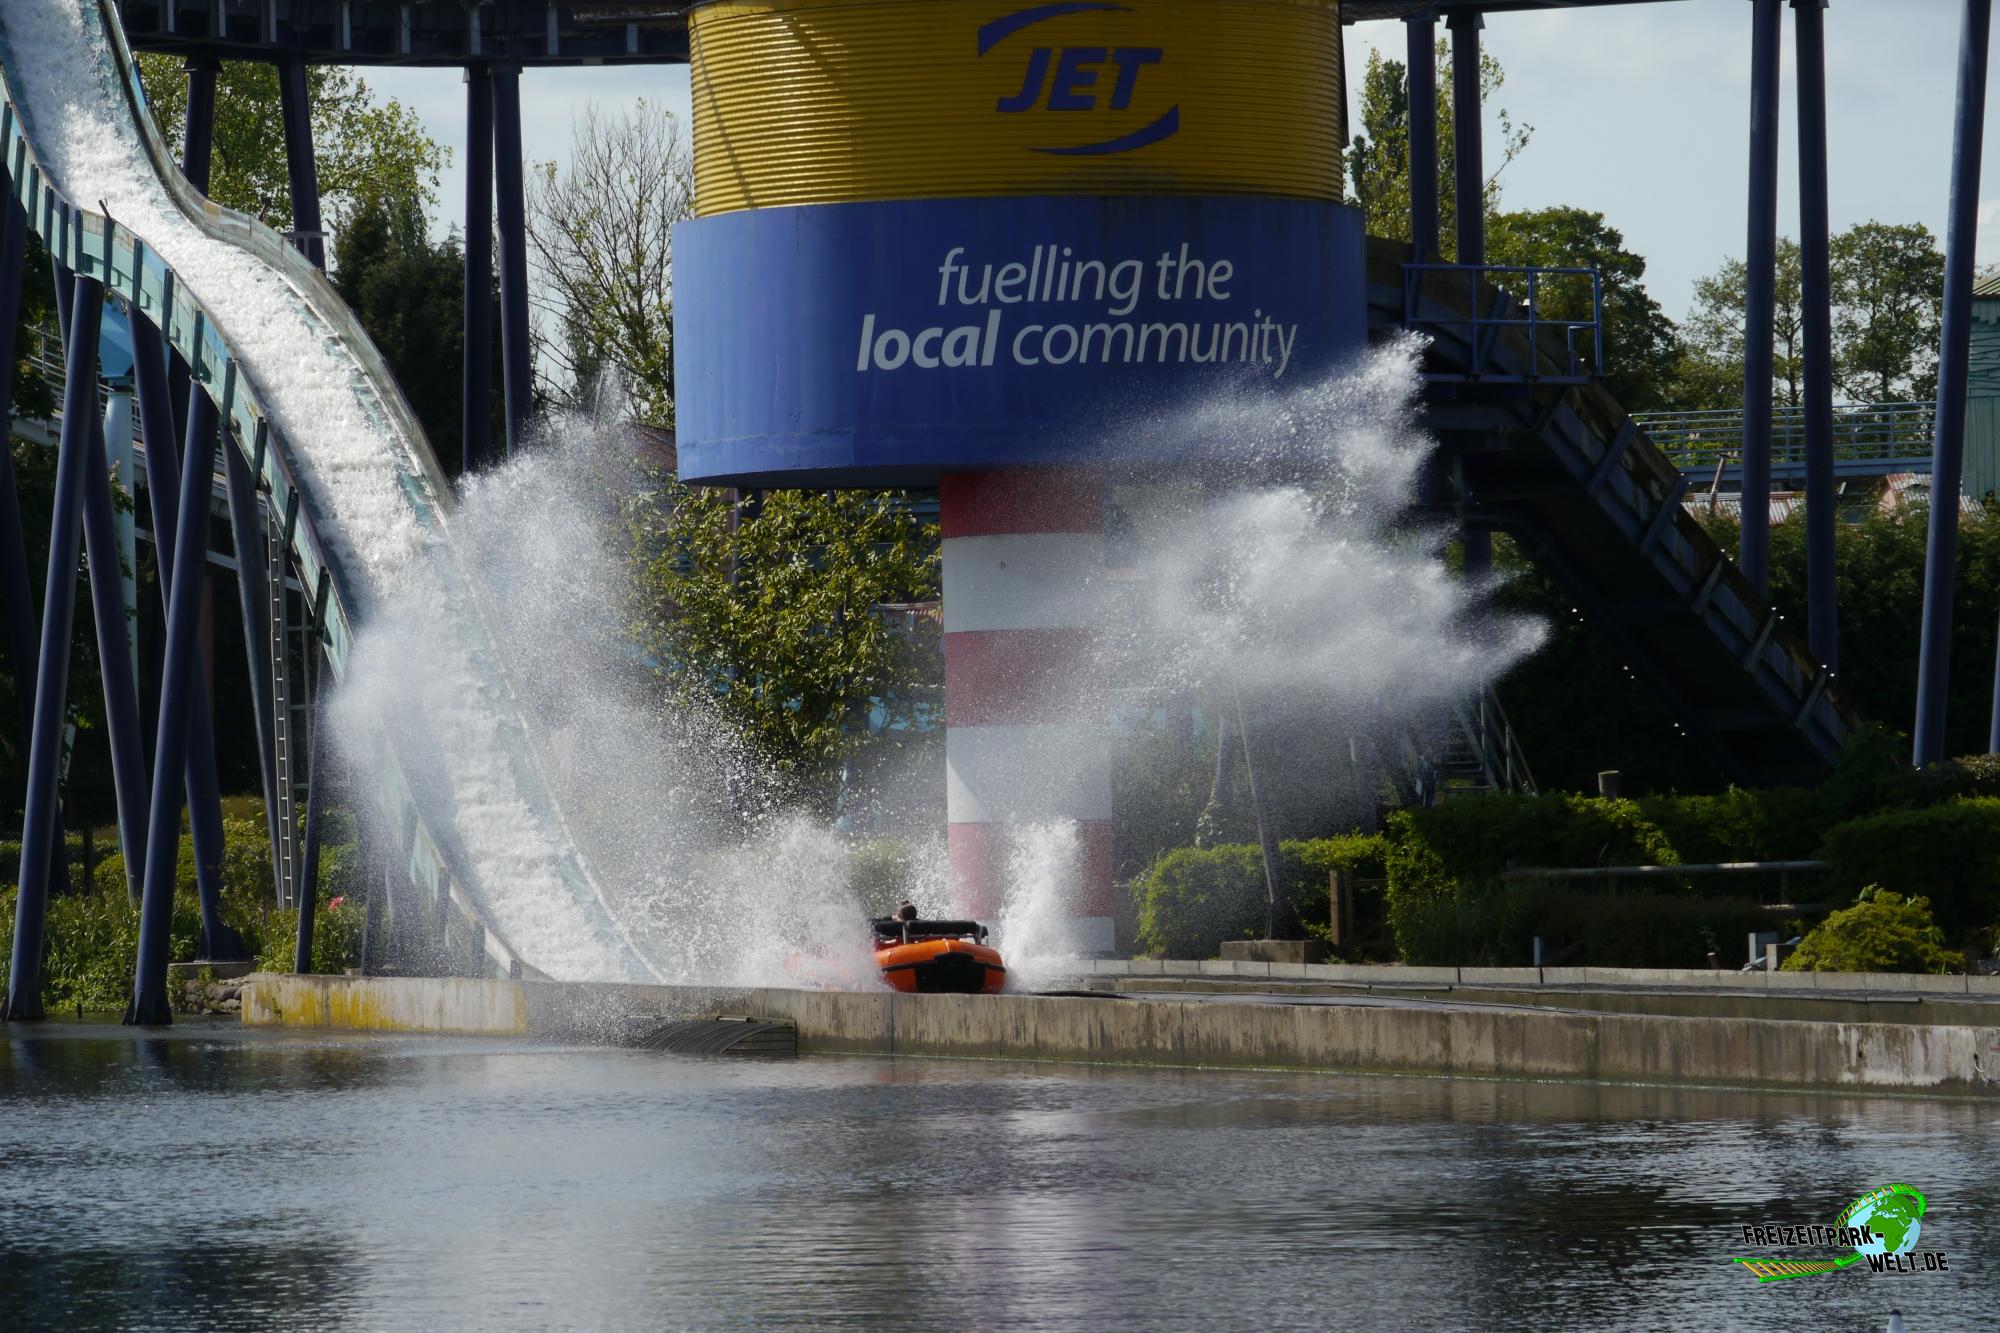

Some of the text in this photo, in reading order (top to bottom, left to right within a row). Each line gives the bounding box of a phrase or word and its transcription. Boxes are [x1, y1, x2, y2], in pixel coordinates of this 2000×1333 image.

[995, 47, 1163, 113] JET
[938, 242, 1234, 316] fuelling the
[856, 308, 1298, 379] local community
